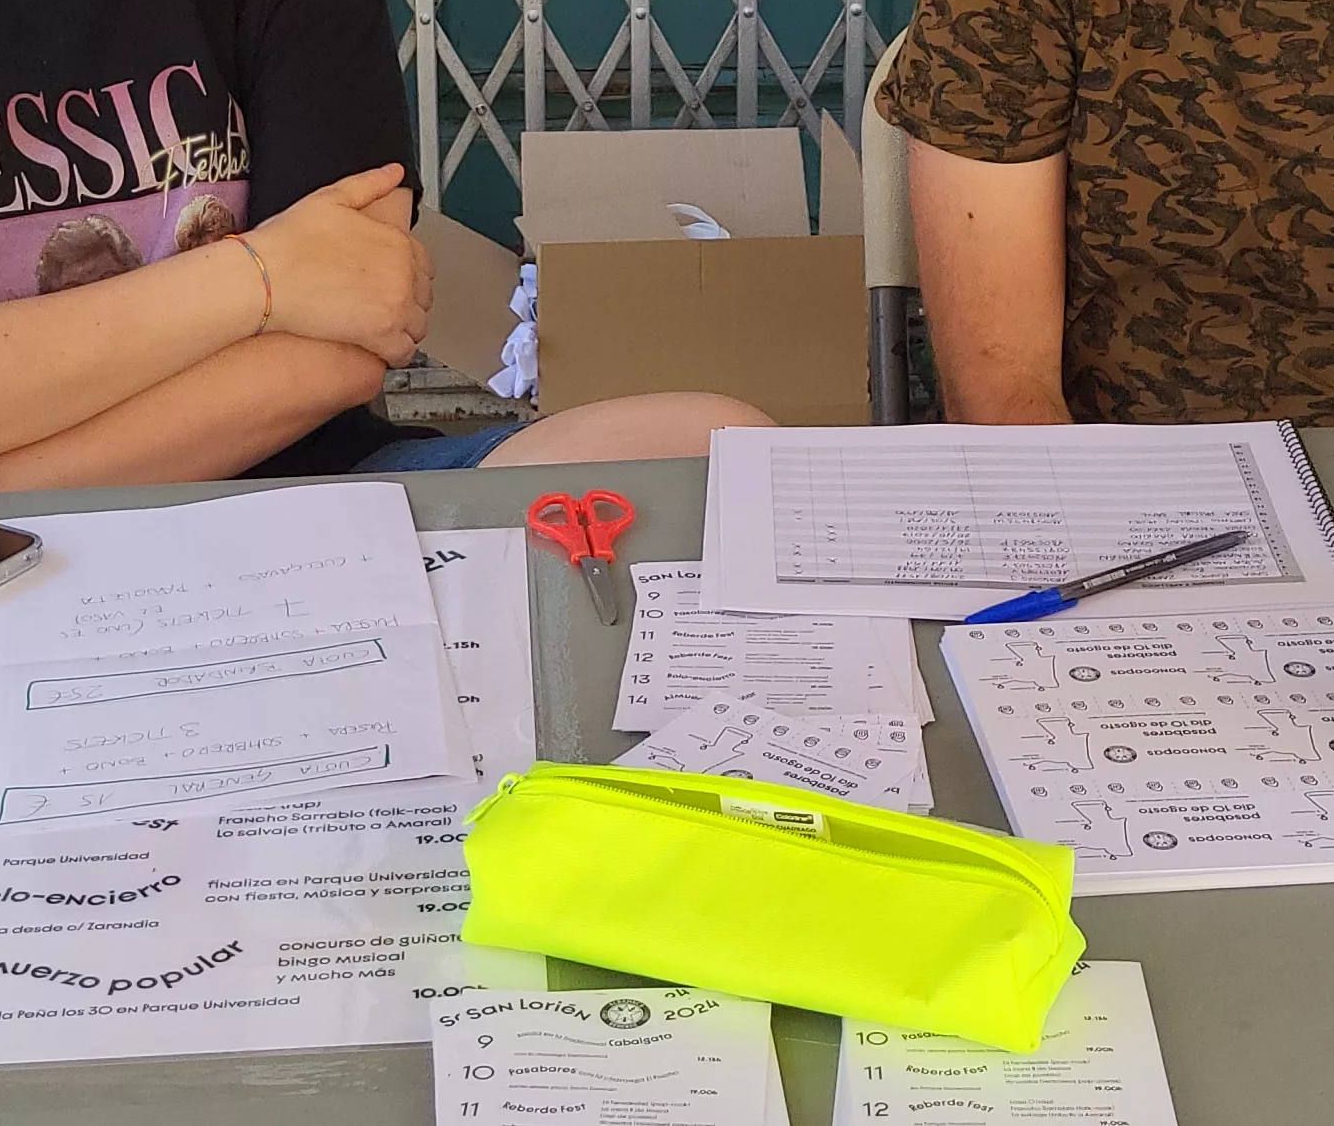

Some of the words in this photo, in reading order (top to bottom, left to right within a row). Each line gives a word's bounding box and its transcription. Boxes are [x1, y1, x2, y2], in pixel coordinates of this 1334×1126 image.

[144, 131, 252, 221] Fletche
[156, 605, 251, 628] TICKETS
[302, 648, 371, 668] CUOTA
[178, 721, 200, 737] 3
[63, 724, 175, 751] TICKETS
[181, 735, 283, 759] SOMBRERO
[299, 755, 372, 775] CUOTA
[166, 767, 272, 795] GENERAL
[218, 814, 288, 825] Francho
[291, 809, 366, 822] Sarrablo
[369, 803, 457, 818] (folk-rock)
[1138, 806, 1187, 815] agosto
[1191, 805, 1209, 813] de
[1213, 804, 1231, 812] 10
[237, 825, 299, 837] salvaje
[302, 823, 367, 836] (tributo
[384, 816, 452, 829] Amaral)
[1183, 814, 1261, 823] pasabares
[3, 857, 56, 869] Parque
[207, 879, 271, 890] finaliza
[304, 874, 364, 886] Parque
[244, 891, 299, 902] fiesta,
[384, 882, 471, 895] sorpresas
[12, 923, 63, 934] desde
[107, 940, 245, 996] popular
[370, 936, 394, 947] de
[276, 975, 286, 984] y
[17, 1008, 58, 1019] Peña
[62, 1007, 85, 1017] los
[88, 1005, 113, 1015] 30
[142, 1002, 199, 1015] Parque
[467, 1002, 513, 1020] San
[520, 999, 591, 1021] Lorién
[664, 999, 720, 1021] 2024
[478, 1035, 493, 1048] 9
[856, 1032, 888, 1045] 10
[463, 1065, 494, 1080] 10
[864, 1066, 882, 1080] 11
[461, 1102, 479, 1116] 11
[863, 1102, 889, 1117] 12
